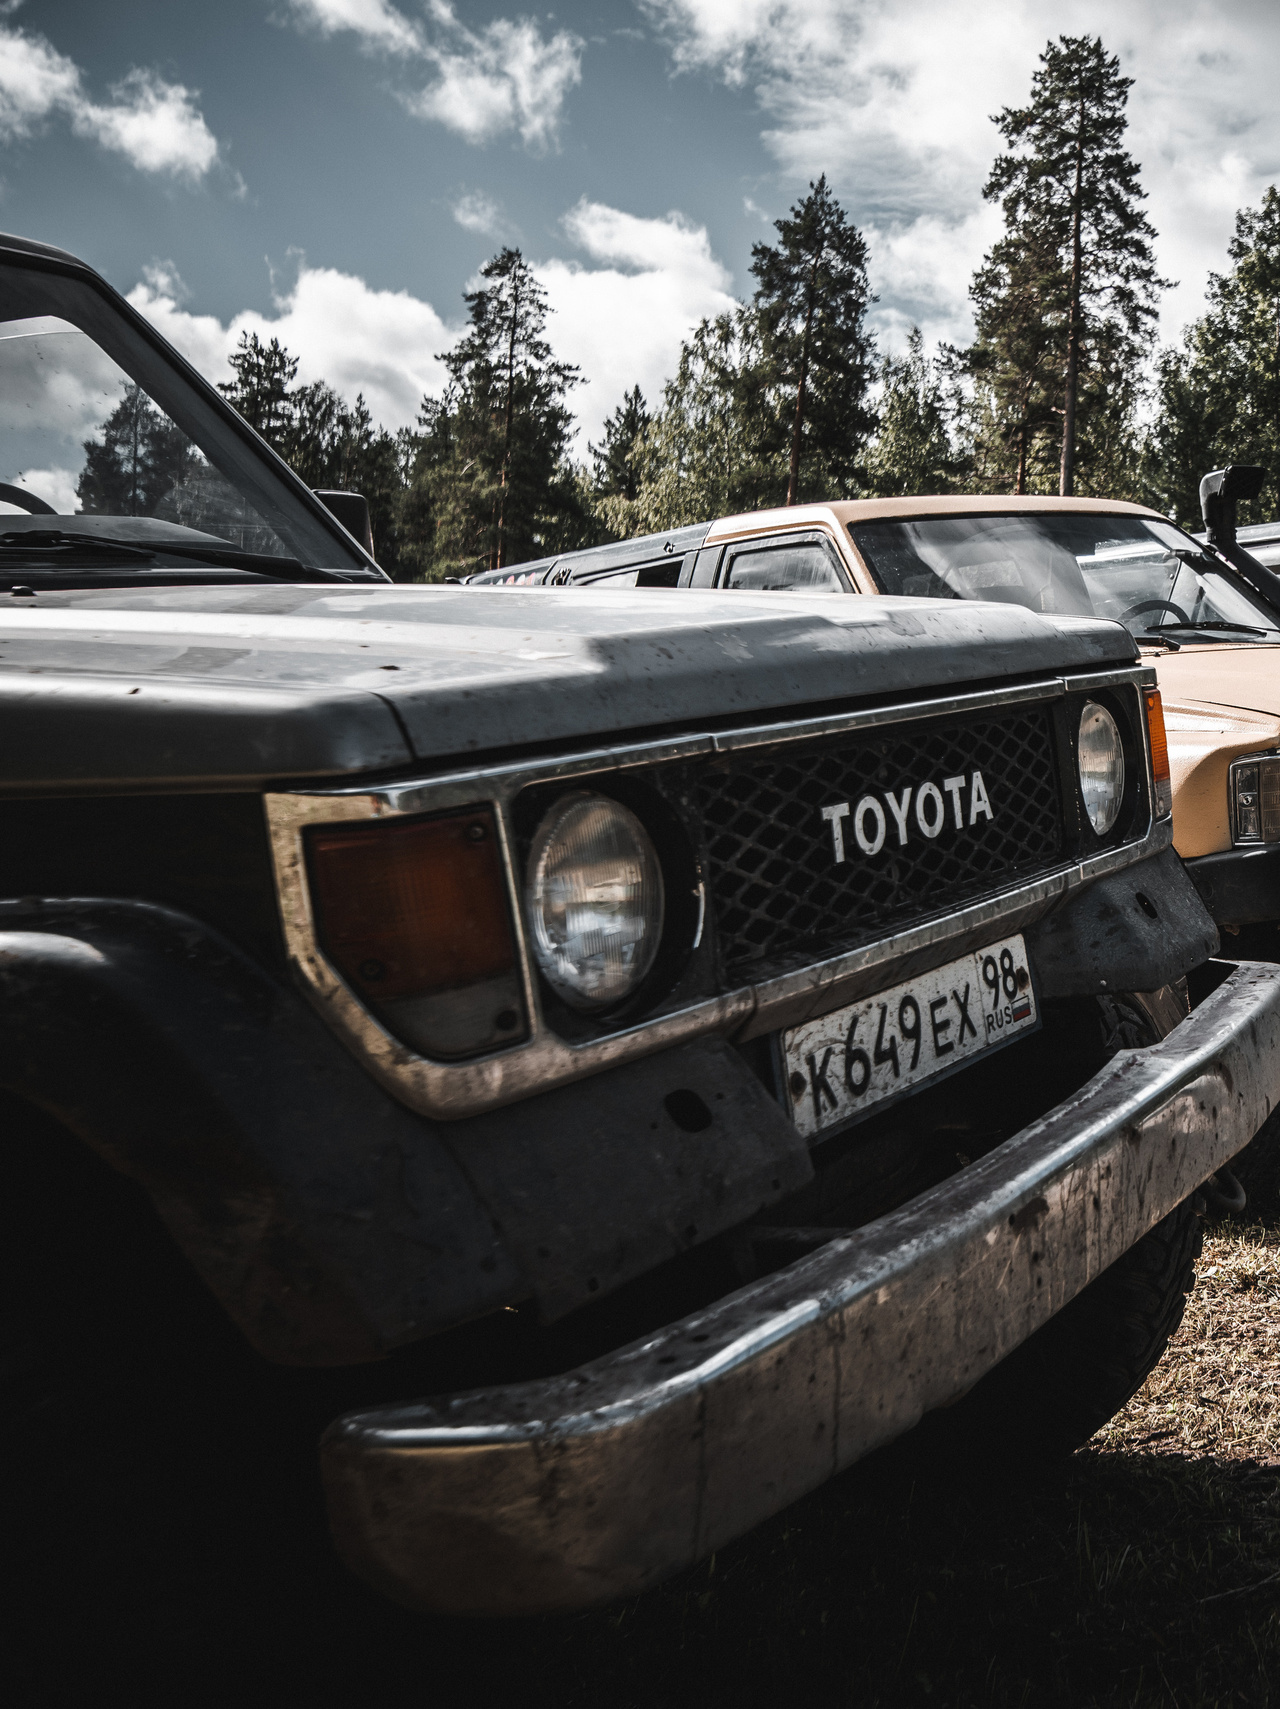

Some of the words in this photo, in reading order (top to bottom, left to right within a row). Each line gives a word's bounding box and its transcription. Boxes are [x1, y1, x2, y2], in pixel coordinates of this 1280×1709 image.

[821, 771, 995, 864] TOYOTA
[982, 947, 1018, 1010] 98
[986, 1007, 1013, 1034] RUS
